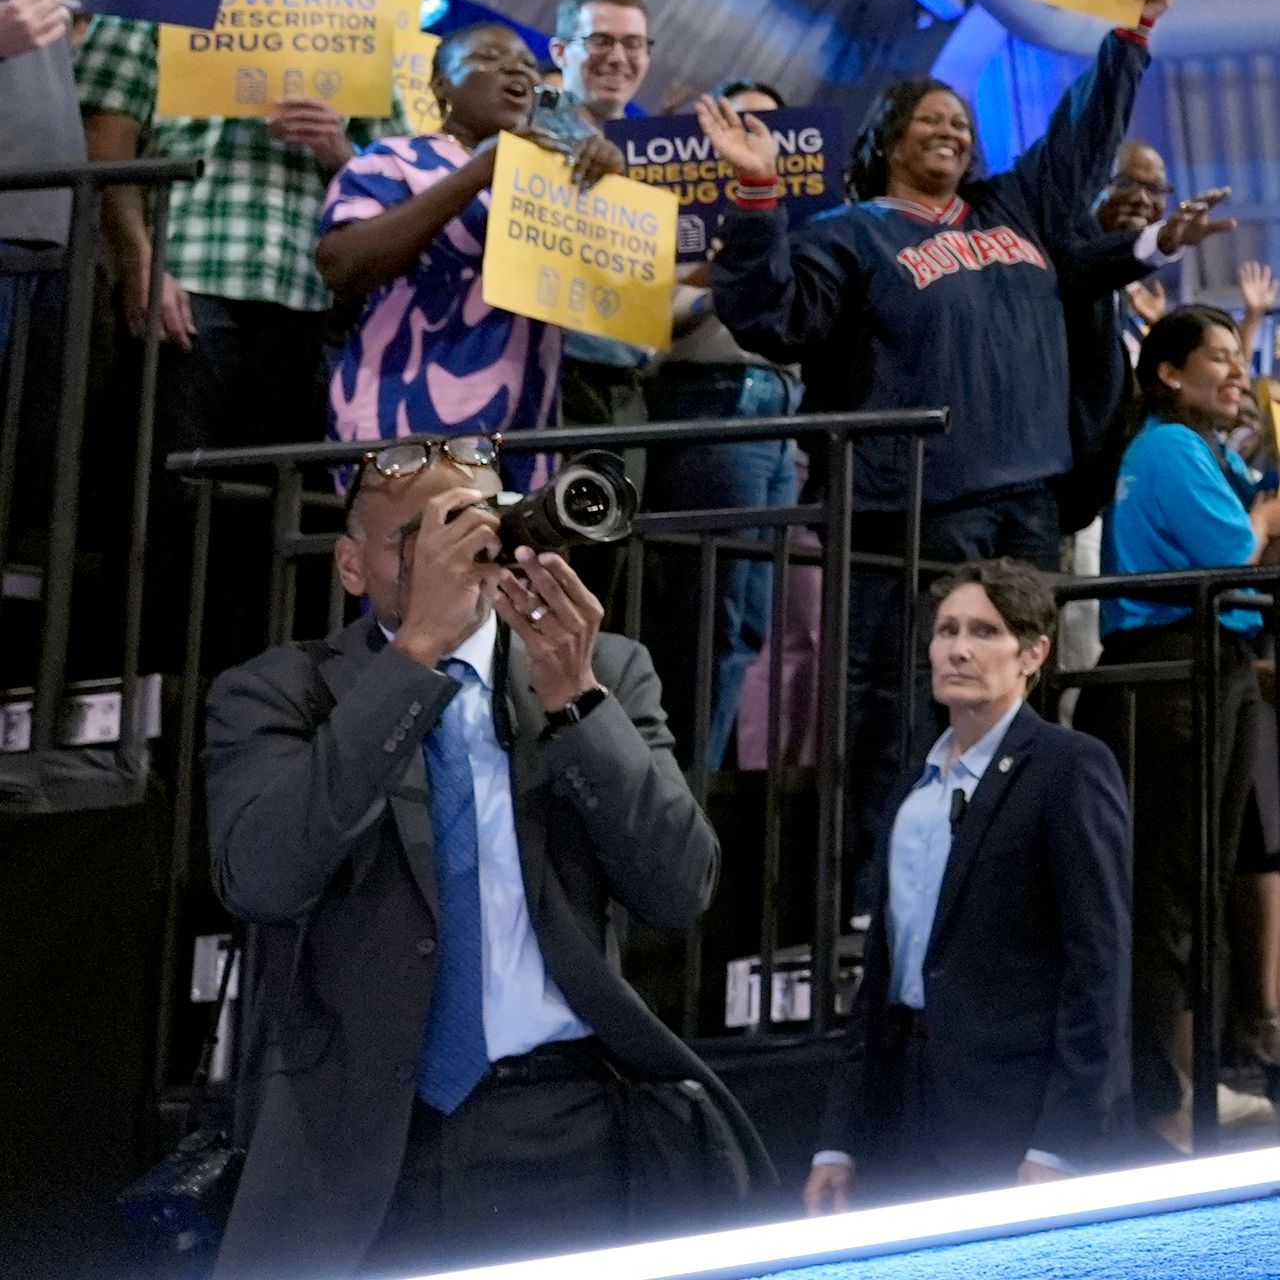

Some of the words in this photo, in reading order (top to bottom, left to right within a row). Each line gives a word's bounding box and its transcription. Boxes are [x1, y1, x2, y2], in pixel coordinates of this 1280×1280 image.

[189, 32, 283, 53] DRUG
[292, 32, 376, 54] COSTS
[626, 127, 823, 165] LOWNG
[628, 152, 825, 183] PRESCRION
[510, 195, 657, 258] PRESCRIPTION
[512, 167, 659, 237] LOWERING
[508, 219, 574, 257] DRUG
[579, 242, 656, 281] COSTS
